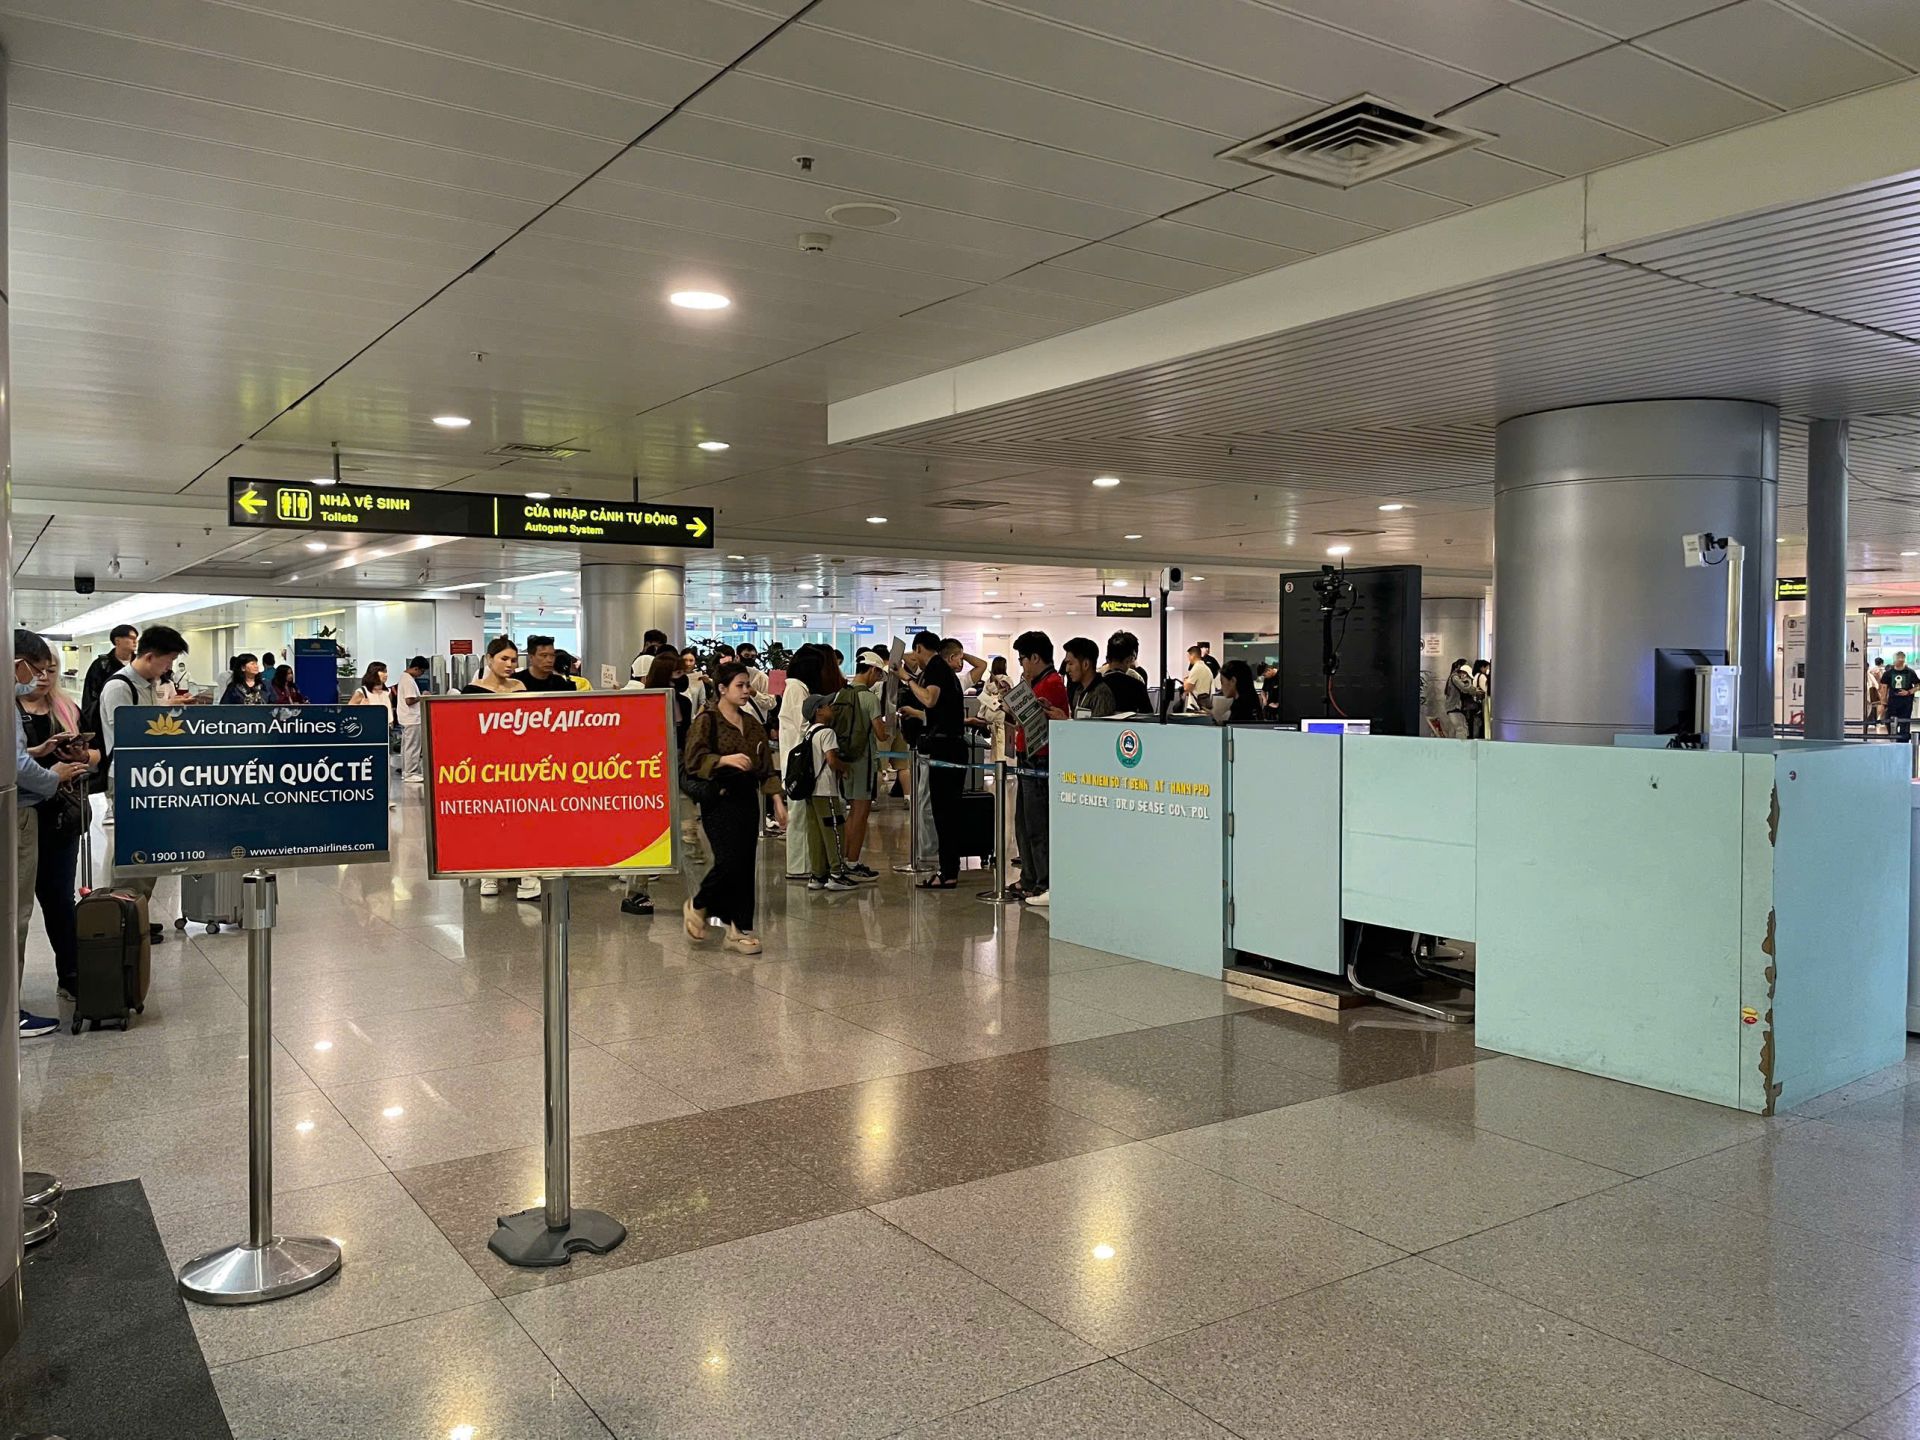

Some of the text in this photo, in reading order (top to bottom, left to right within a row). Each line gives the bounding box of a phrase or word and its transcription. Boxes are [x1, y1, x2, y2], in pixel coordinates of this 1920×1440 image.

[319, 493, 410, 511] NHÀ VỆ SINH
[320, 511, 359, 523] Toilets
[524, 503, 678, 526] CỬA NHẬP CẢNH TỰ ĐỘNG
[525, 522, 604, 535] Autogate System
[538, 608, 544, 616] 7
[802, 614, 807, 622] 3
[860, 616, 865, 624] 2
[186, 717, 337, 735] Vietnam Airlines
[130, 755, 374, 788] NỐI CHUYẾN QUỐC TẾ
[438, 751, 664, 784] NỐI CHUYẾN QUỐC TẾ
[130, 788, 375, 810] INTERNATIONAL CONNECTIONS
[440, 794, 665, 815] INTERNATIONAL CONNECTIONS
[151, 850, 206, 862] 1900 1100
[250, 842, 375, 857] www.vietnamairlines.com
